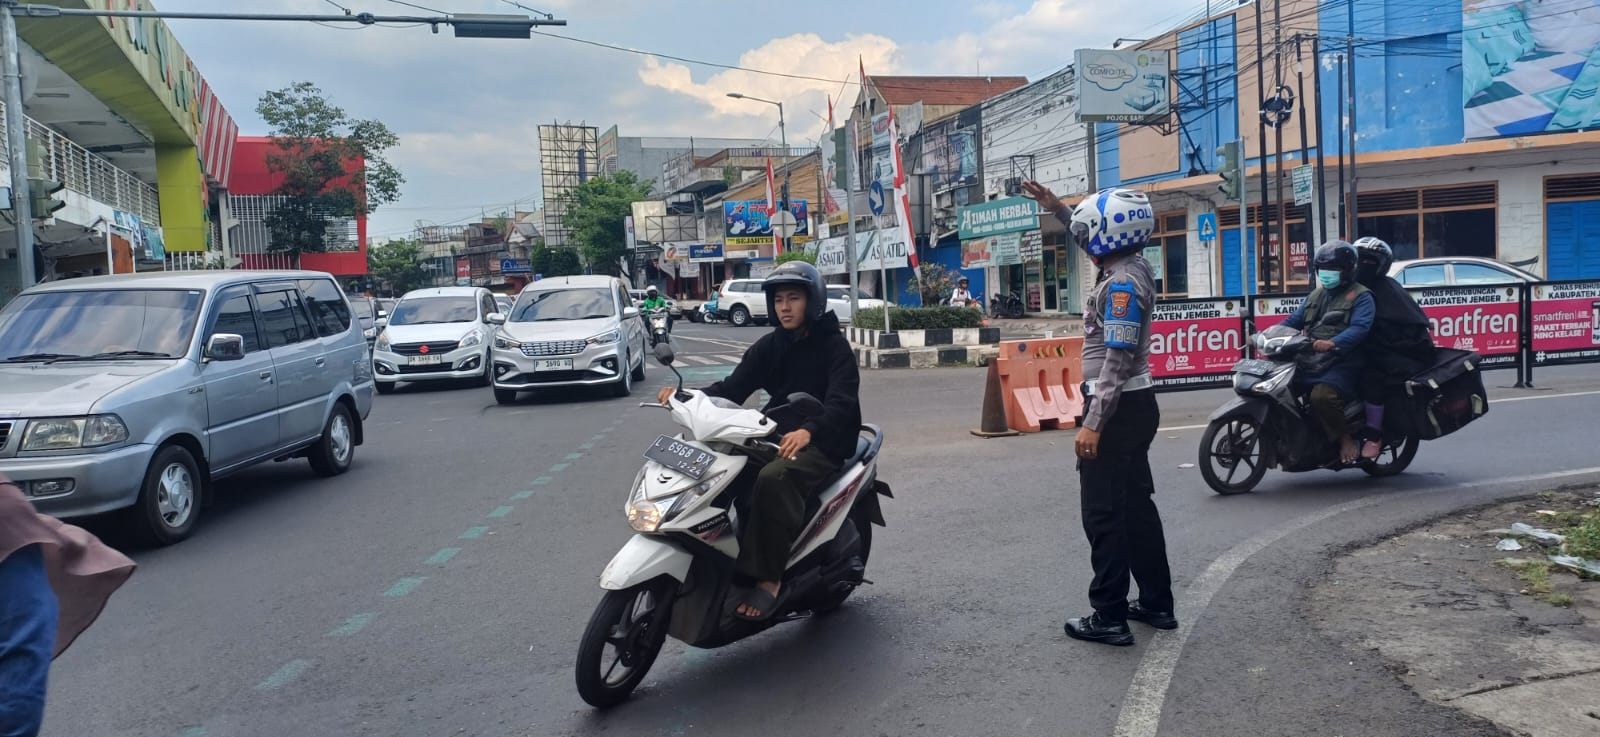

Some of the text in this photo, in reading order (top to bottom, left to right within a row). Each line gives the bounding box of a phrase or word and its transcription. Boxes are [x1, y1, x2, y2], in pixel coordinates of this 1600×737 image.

[999, 202, 1033, 219] HERBAL
[1422, 287, 1497, 298] DINAS PERHUBUNGAN
[1548, 290, 1596, 300] KABUPATEN
[1417, 294, 1502, 306] KABUPATEN JEMBER
[1156, 303, 1215, 312] PERHUBUNGAN
[1184, 310, 1221, 320] JEMBER
[1534, 310, 1575, 322] smartfren
[1534, 322, 1591, 332] PAKET TERBAIK
[1534, 331, 1554, 339] NING
[655, 437, 713, 466] L 6968 BX
